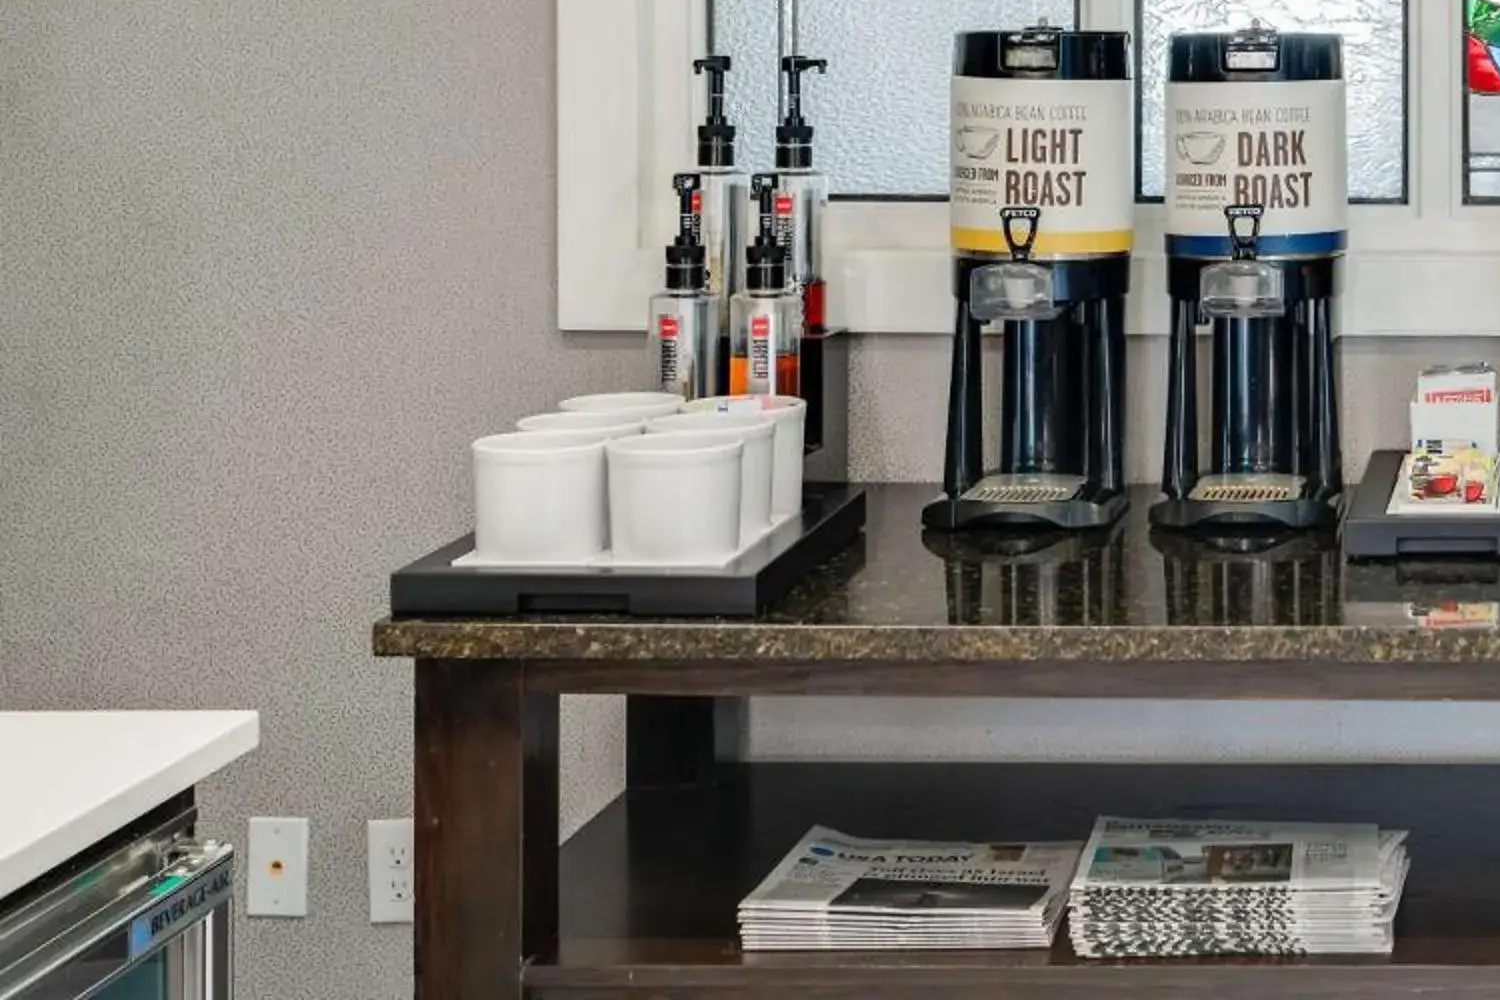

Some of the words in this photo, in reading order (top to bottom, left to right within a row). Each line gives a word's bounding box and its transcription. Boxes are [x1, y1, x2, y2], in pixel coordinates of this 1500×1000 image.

[1006, 127, 1083, 164] LIGHT
[1237, 130, 1306, 166] DARK
[1005, 169, 1087, 206] ROAST
[1234, 171, 1312, 209] ROAST
[1005, 209, 1037, 217] FETCO
[838, 851, 886, 863] USA
[894, 852, 973, 864] TODAY
